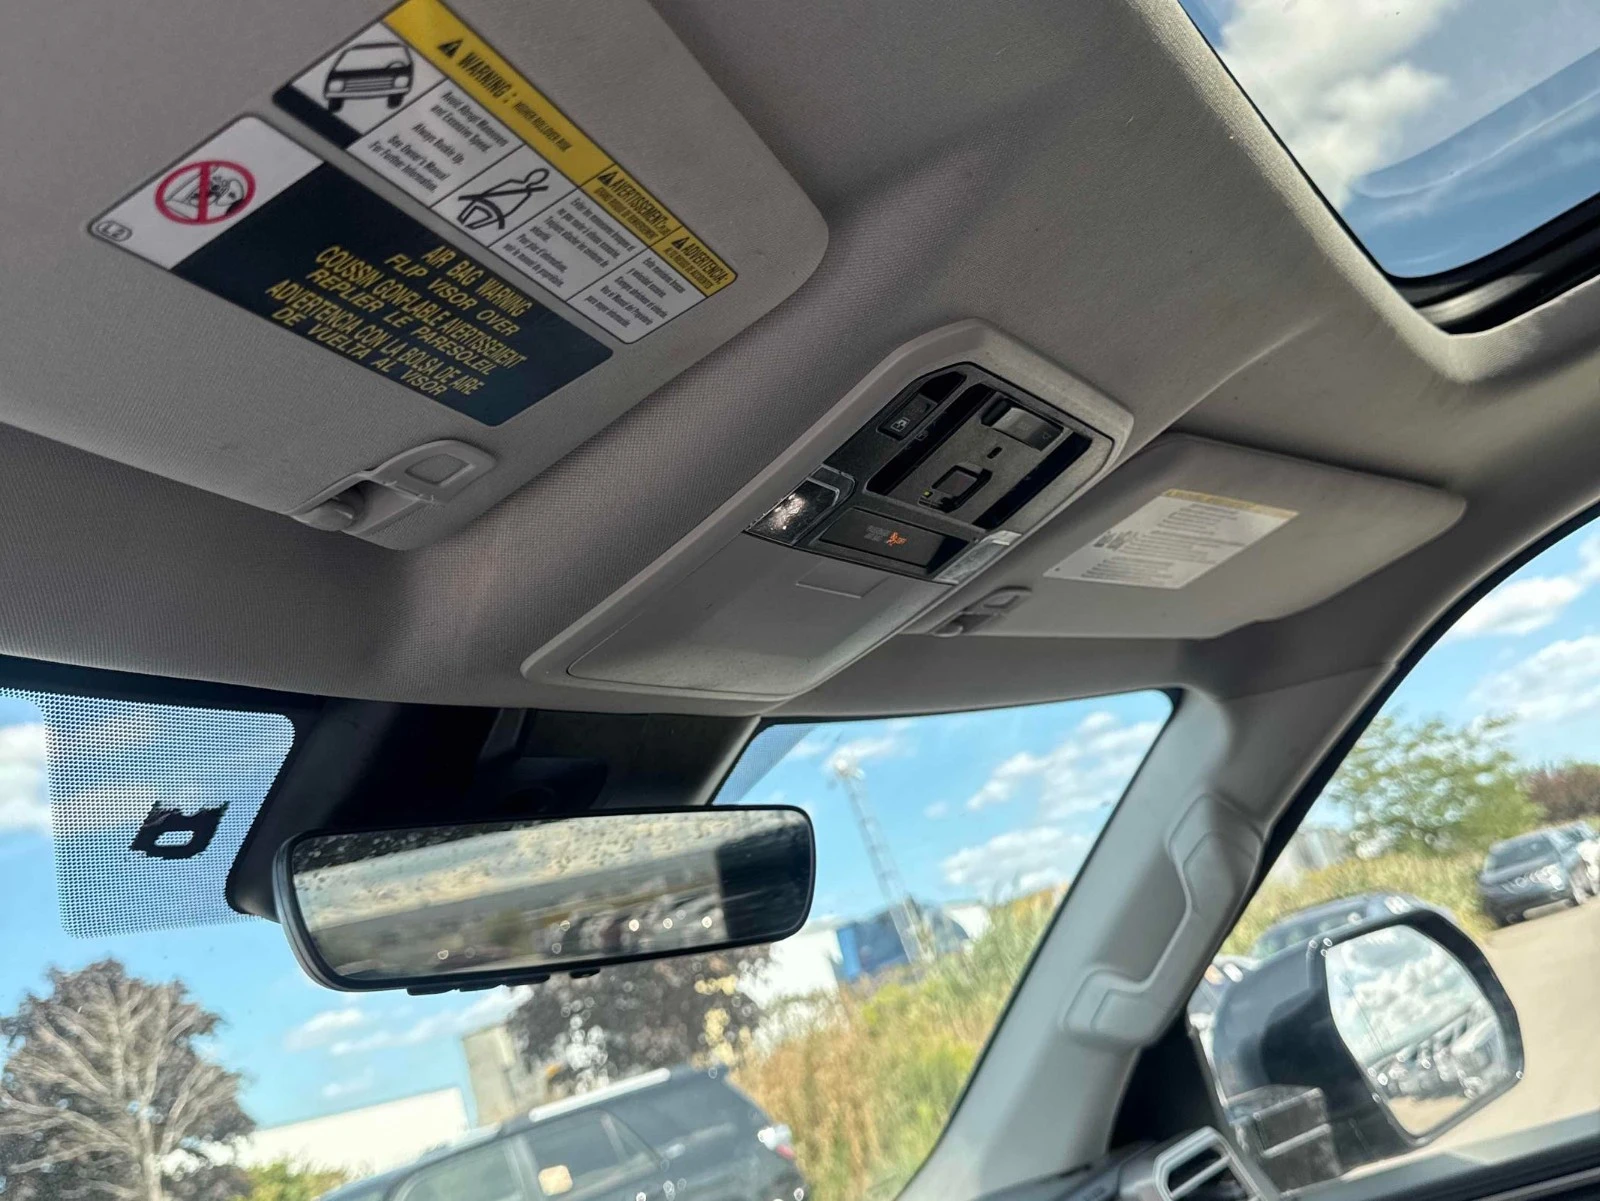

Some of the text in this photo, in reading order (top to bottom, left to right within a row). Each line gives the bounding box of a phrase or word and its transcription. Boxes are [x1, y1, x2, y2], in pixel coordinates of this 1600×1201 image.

[460, 53, 512, 97] WARNING
[316, 246, 527, 368] COUSSIN GONFLABLE AVERTISSEMENT
[384, 253, 520, 337] FLIP VISOR OVER
[421, 245, 533, 317] AIR BAG WARNING
[682, 245, 726, 283] ADVERTENCIA:
[266, 280, 485, 395] ADVERTENCIA CON LA BOLSA DE AIRE
[272, 307, 448, 396] DE VUELTA AL VISOR
[306, 268, 497, 375] REPLIER LE PARESOLEIL
